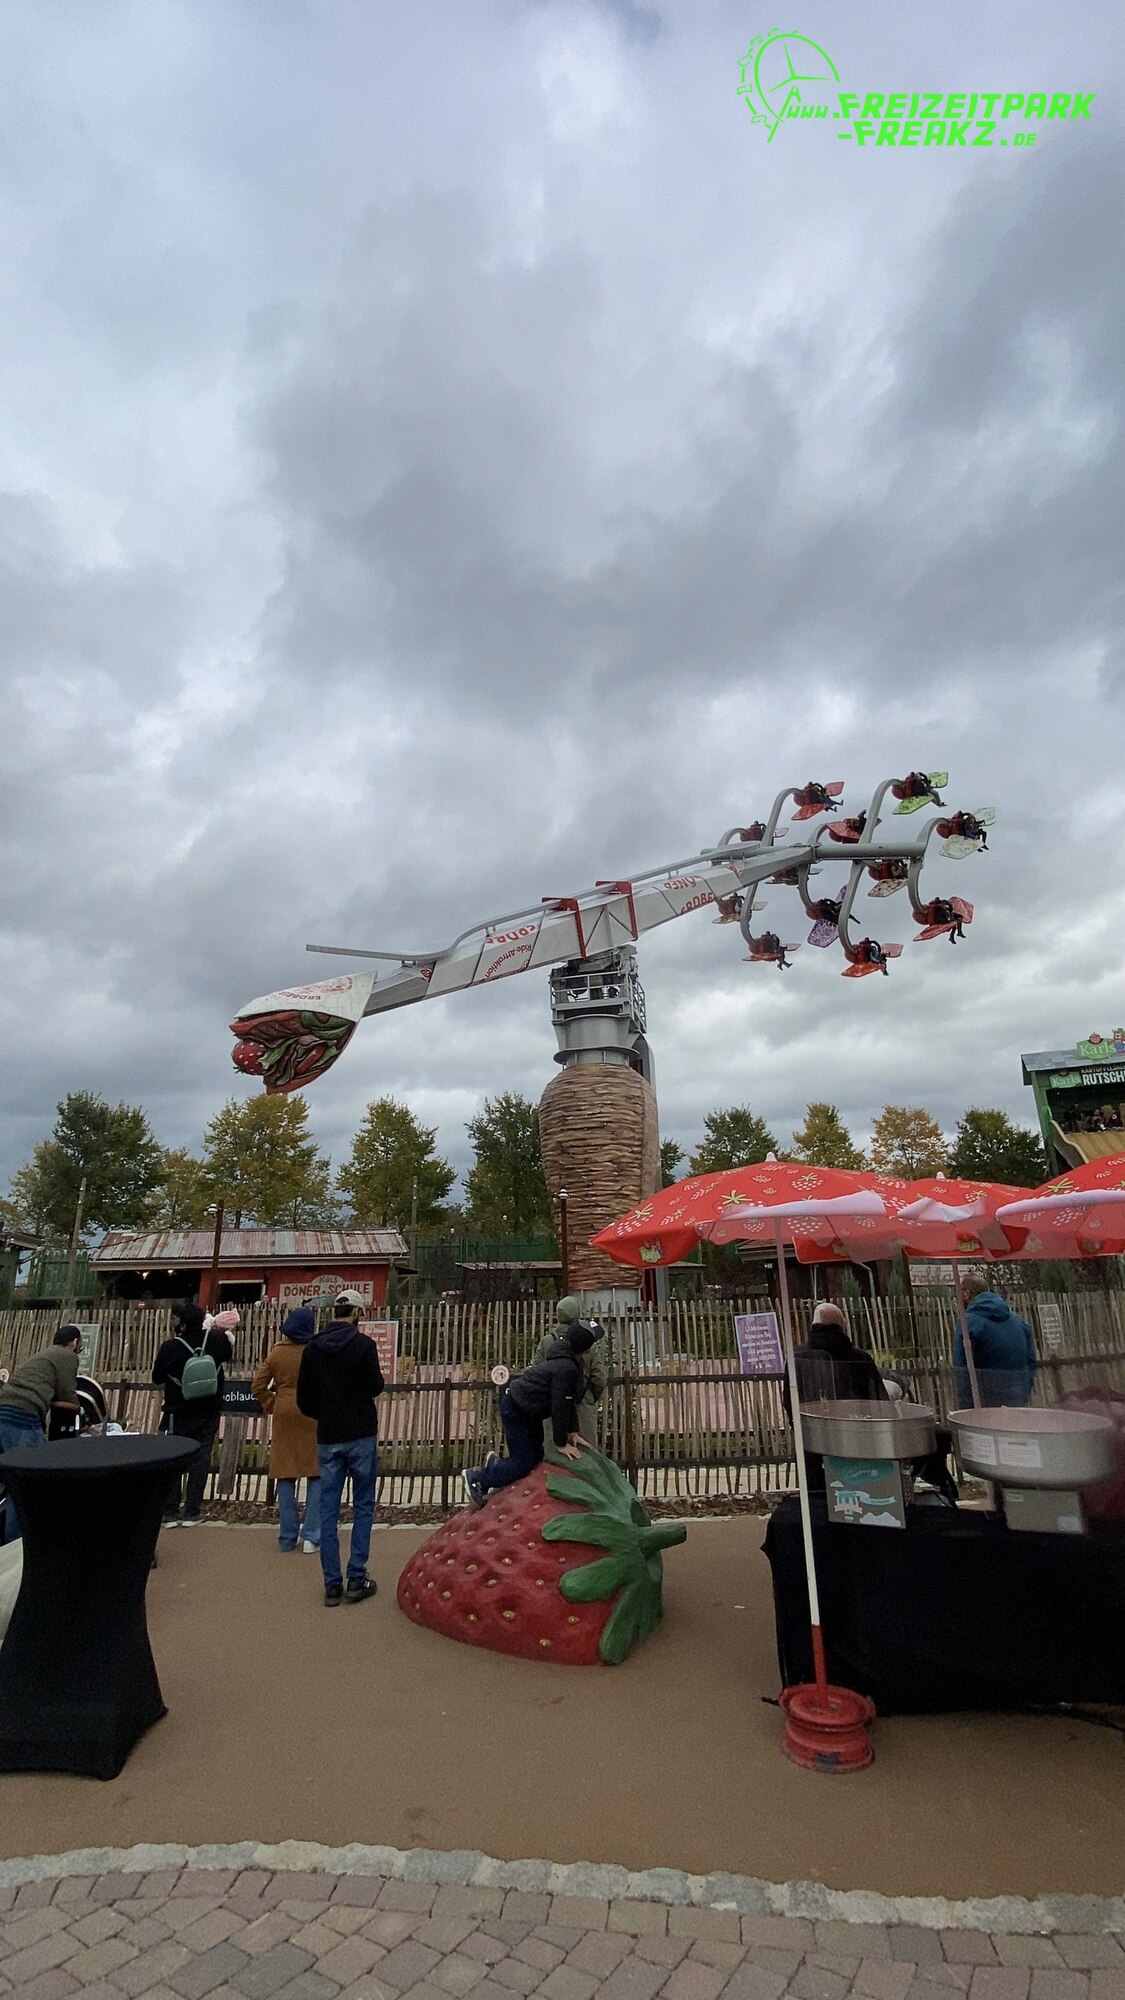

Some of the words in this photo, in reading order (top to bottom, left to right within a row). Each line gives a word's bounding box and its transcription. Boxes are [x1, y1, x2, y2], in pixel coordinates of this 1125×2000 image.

[484, 944, 533, 978] Ride-Attraktion
[1080, 1041, 1117, 1056] Karls
[1052, 1074, 1081, 1087] Karls
[284, 1284, 321, 1297] DÖNER
[223, 1390, 259, 1402] oblauc
